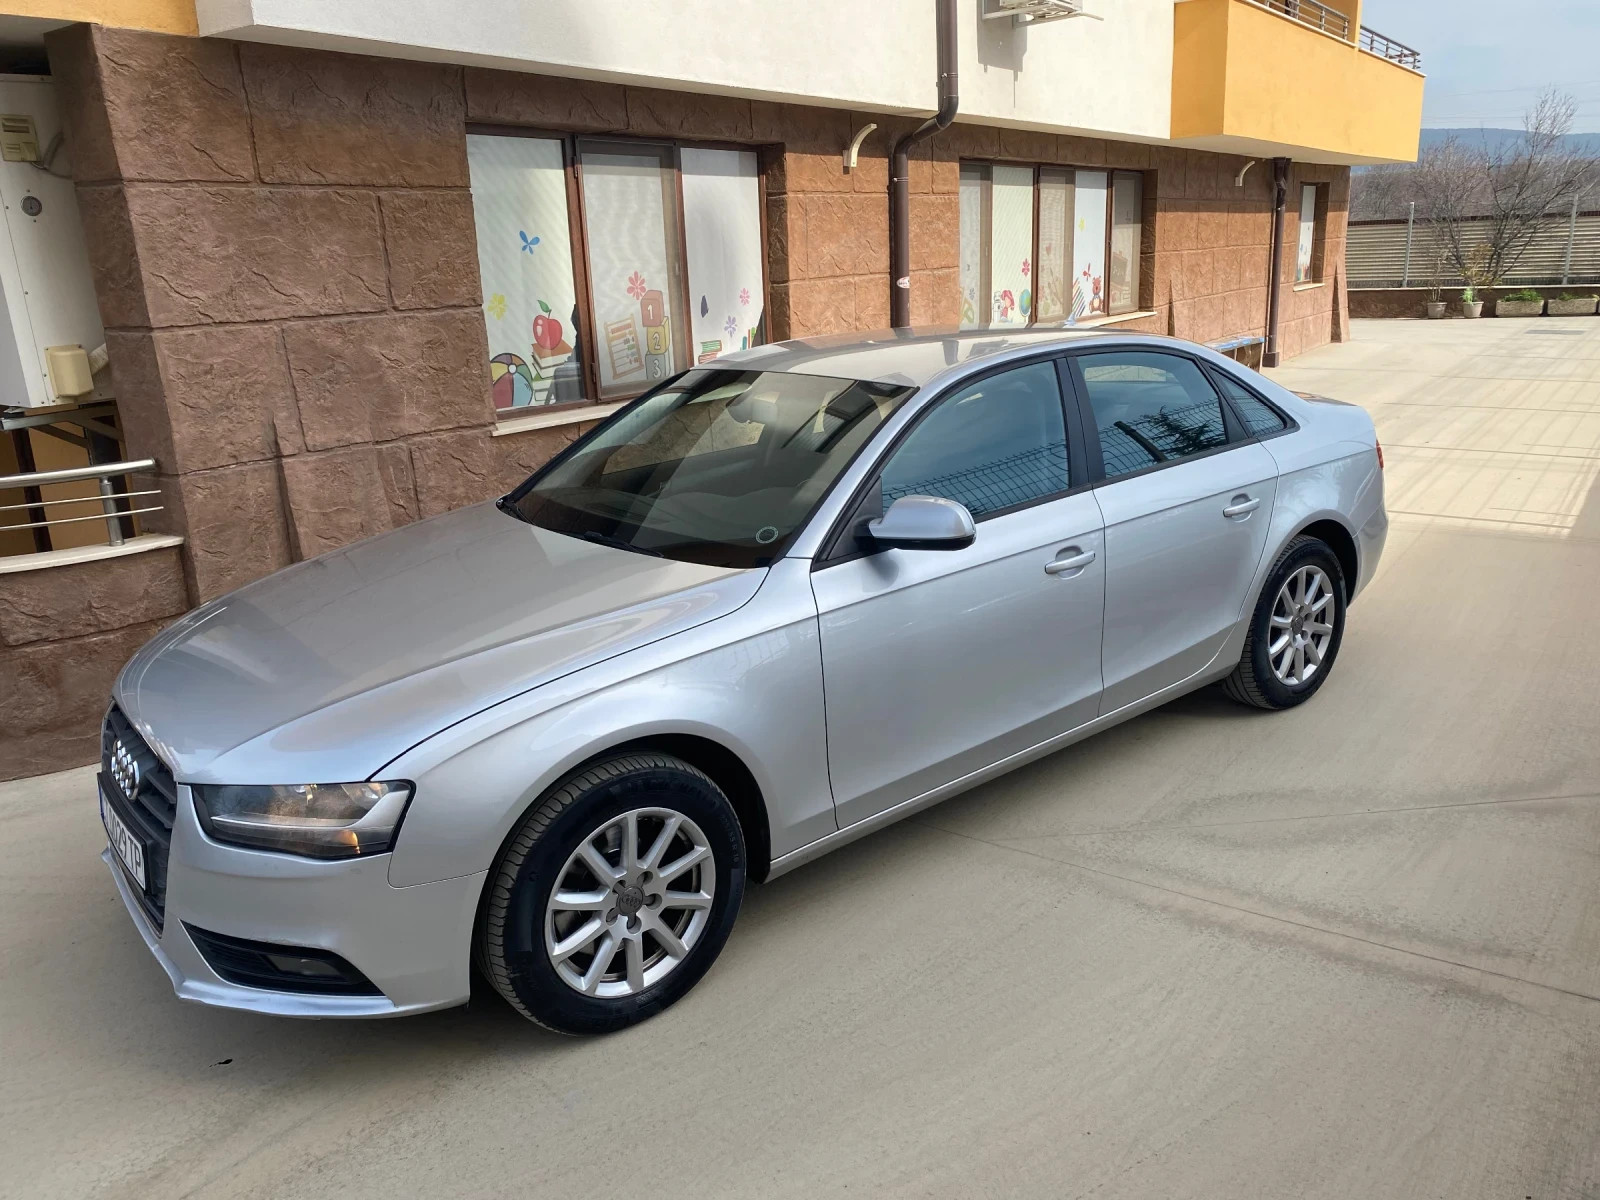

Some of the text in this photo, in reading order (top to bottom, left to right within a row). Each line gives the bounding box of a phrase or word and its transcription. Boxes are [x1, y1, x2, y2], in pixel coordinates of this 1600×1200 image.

[648, 304, 653, 320] 1
[653, 332, 661, 350] 2
[653, 358, 661, 378] 3
